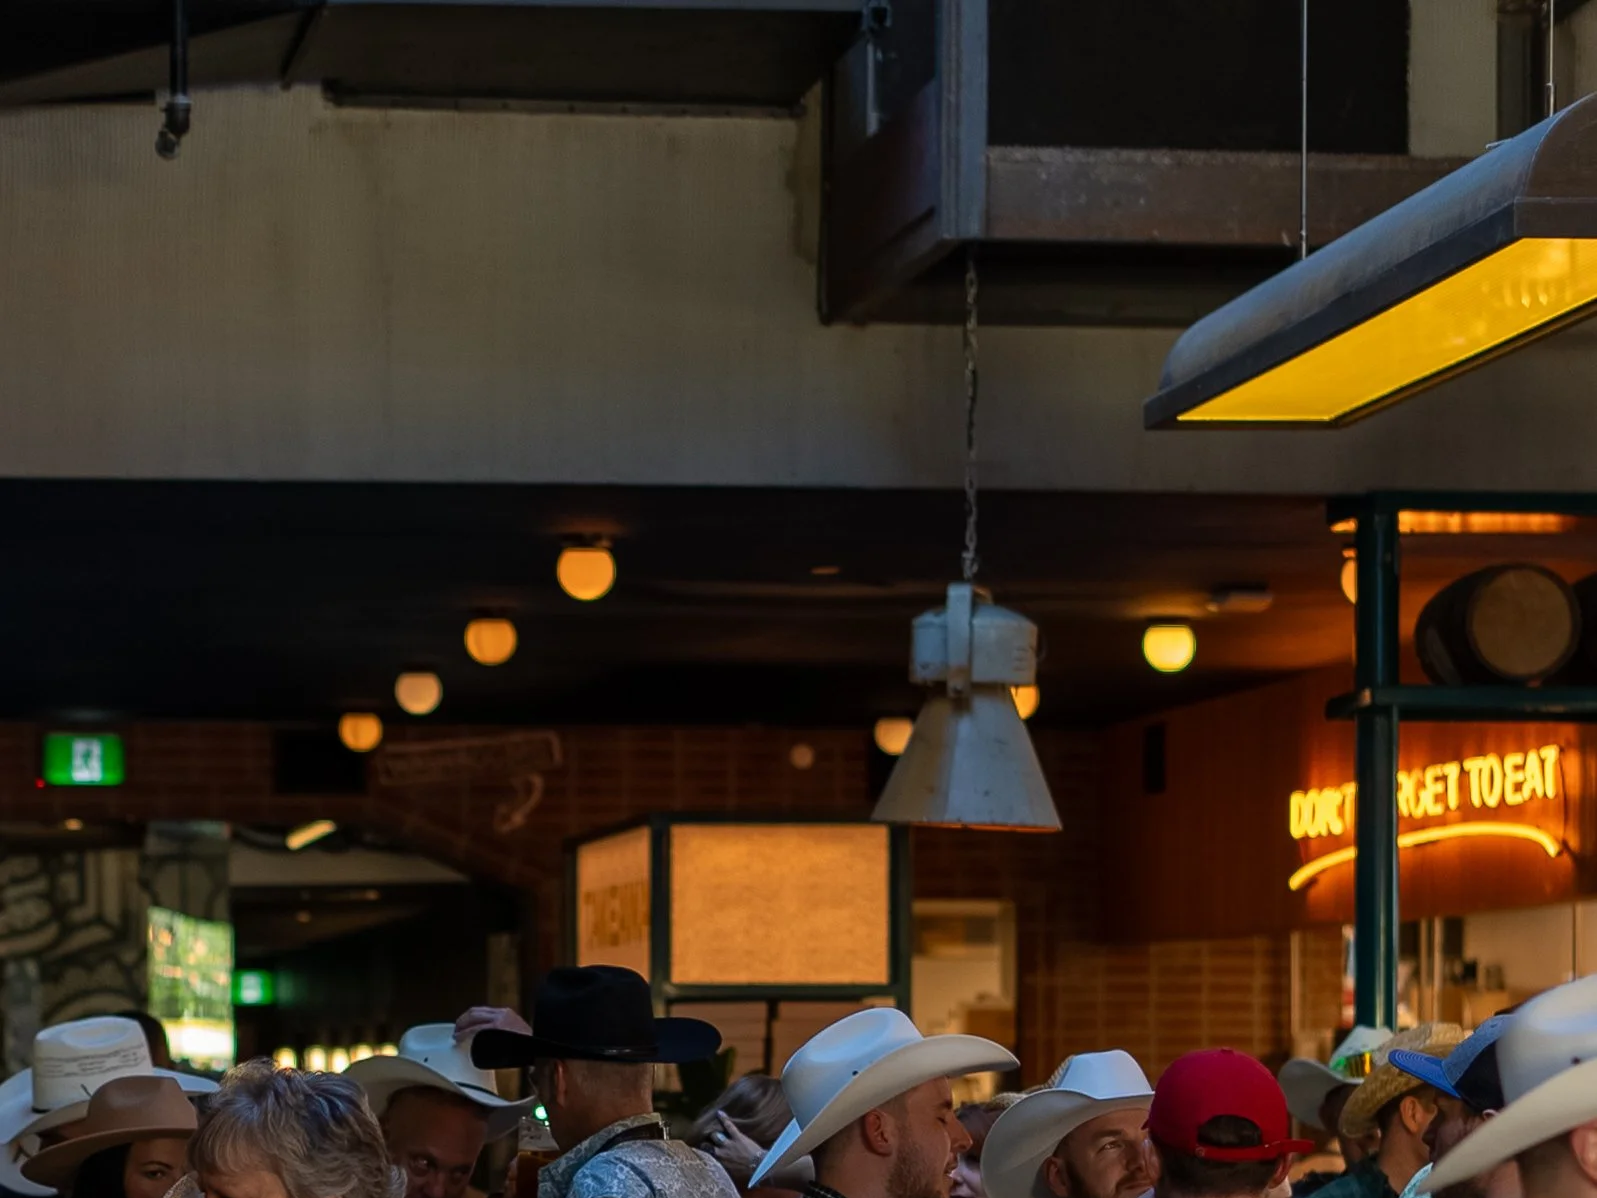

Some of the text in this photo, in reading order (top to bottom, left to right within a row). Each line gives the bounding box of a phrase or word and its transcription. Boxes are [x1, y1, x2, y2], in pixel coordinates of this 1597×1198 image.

[1396, 761, 1460, 819] RGET
[1463, 752, 1503, 809] TO
[1504, 744, 1560, 806] EAT
